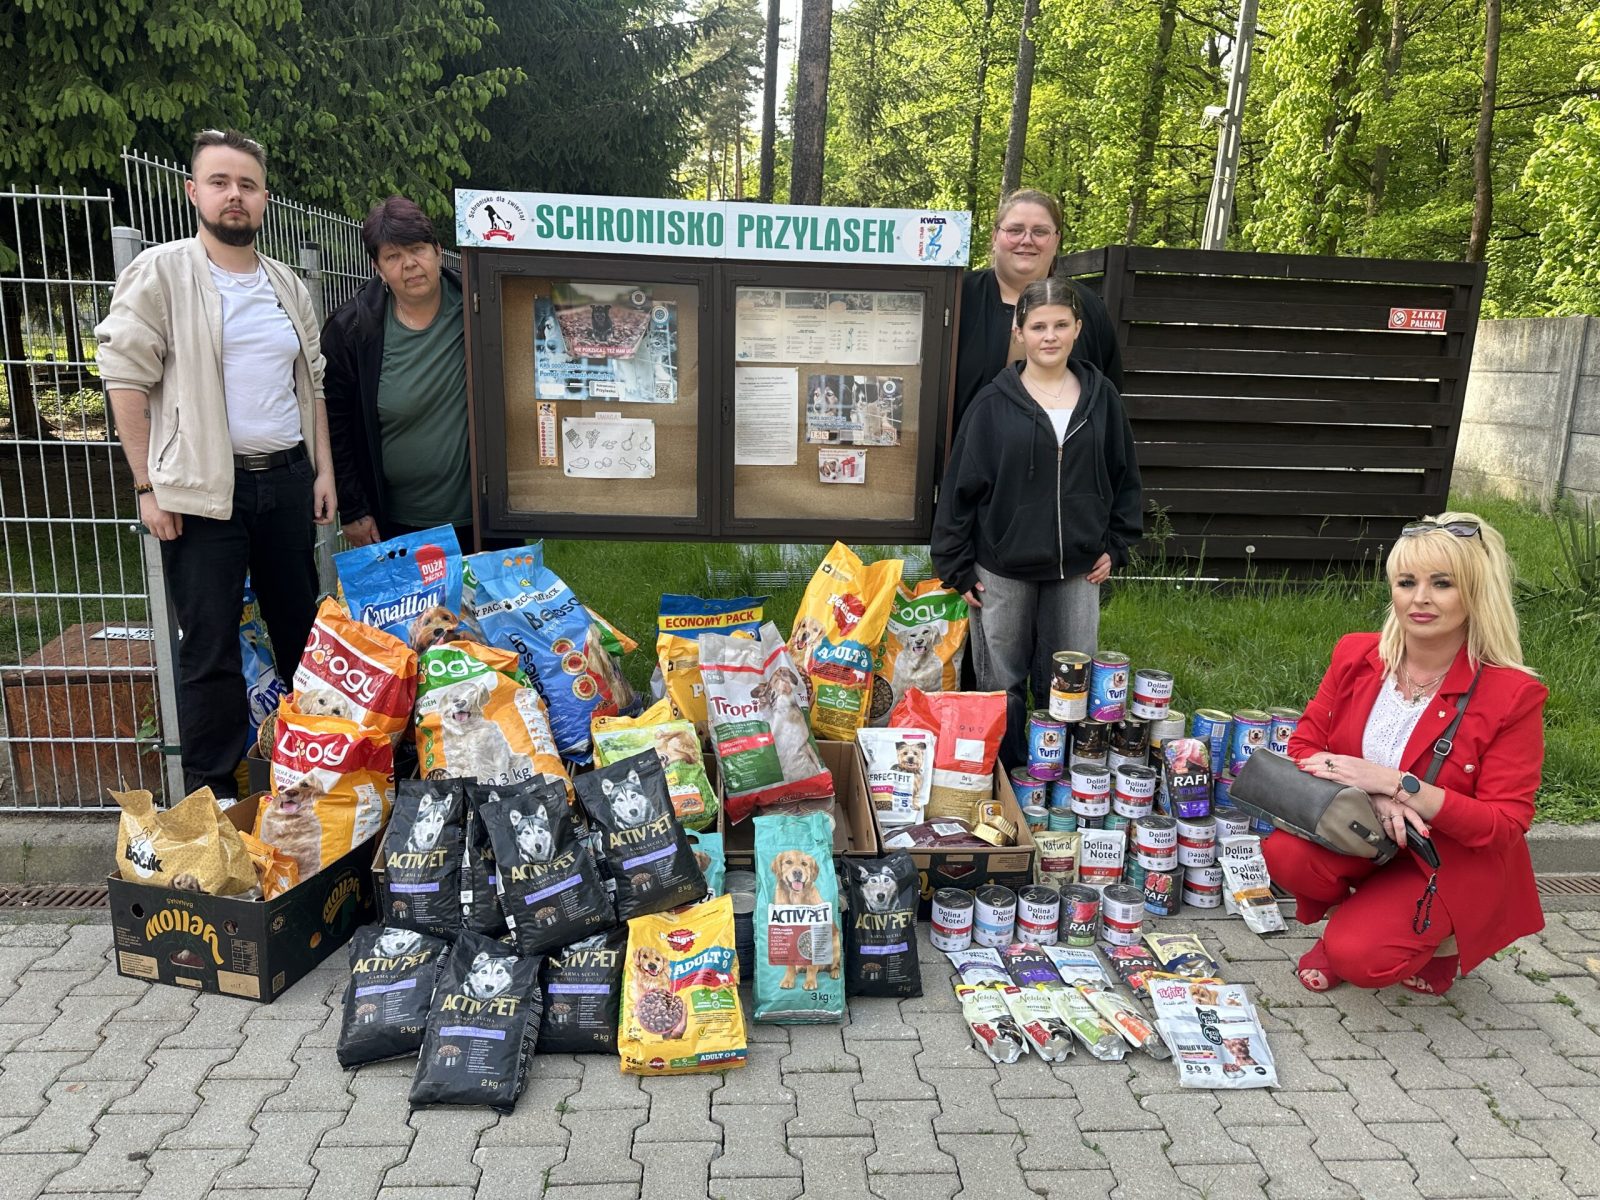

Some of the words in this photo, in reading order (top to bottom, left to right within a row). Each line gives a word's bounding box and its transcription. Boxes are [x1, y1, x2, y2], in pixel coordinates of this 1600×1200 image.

[536, 204, 724, 246] SCHRONISKO
[737, 214, 896, 254] PRZYLASEK
[1412, 310, 1442, 320] ZAKAZ
[1410, 320, 1440, 328] PALENIA
[422, 558, 444, 574] DUŻA
[363, 592, 439, 628] Canaillou
[665, 616, 722, 628] ECONOMY
[726, 611, 754, 624] PACK
[818, 646, 860, 662] ADULT
[512, 768, 531, 780] kg
[1174, 774, 1208, 786] RAFI
[1043, 837, 1072, 850] Natural
[1084, 841, 1113, 850] Dolina
[1091, 850, 1120, 858] Noteci
[1225, 847, 1253, 855] Dolina
[1144, 889, 1168, 902] RAFI
[938, 908, 961, 918] Dolina
[1028, 905, 1050, 914] Dolina
[1070, 922, 1096, 932] RAFI
[674, 952, 721, 976] ADULT
[1012, 956, 1049, 964] RAFI
[811, 992, 817, 1000] 3
[819, 992, 829, 1003] kg
[489, 1080, 498, 1089] kg
